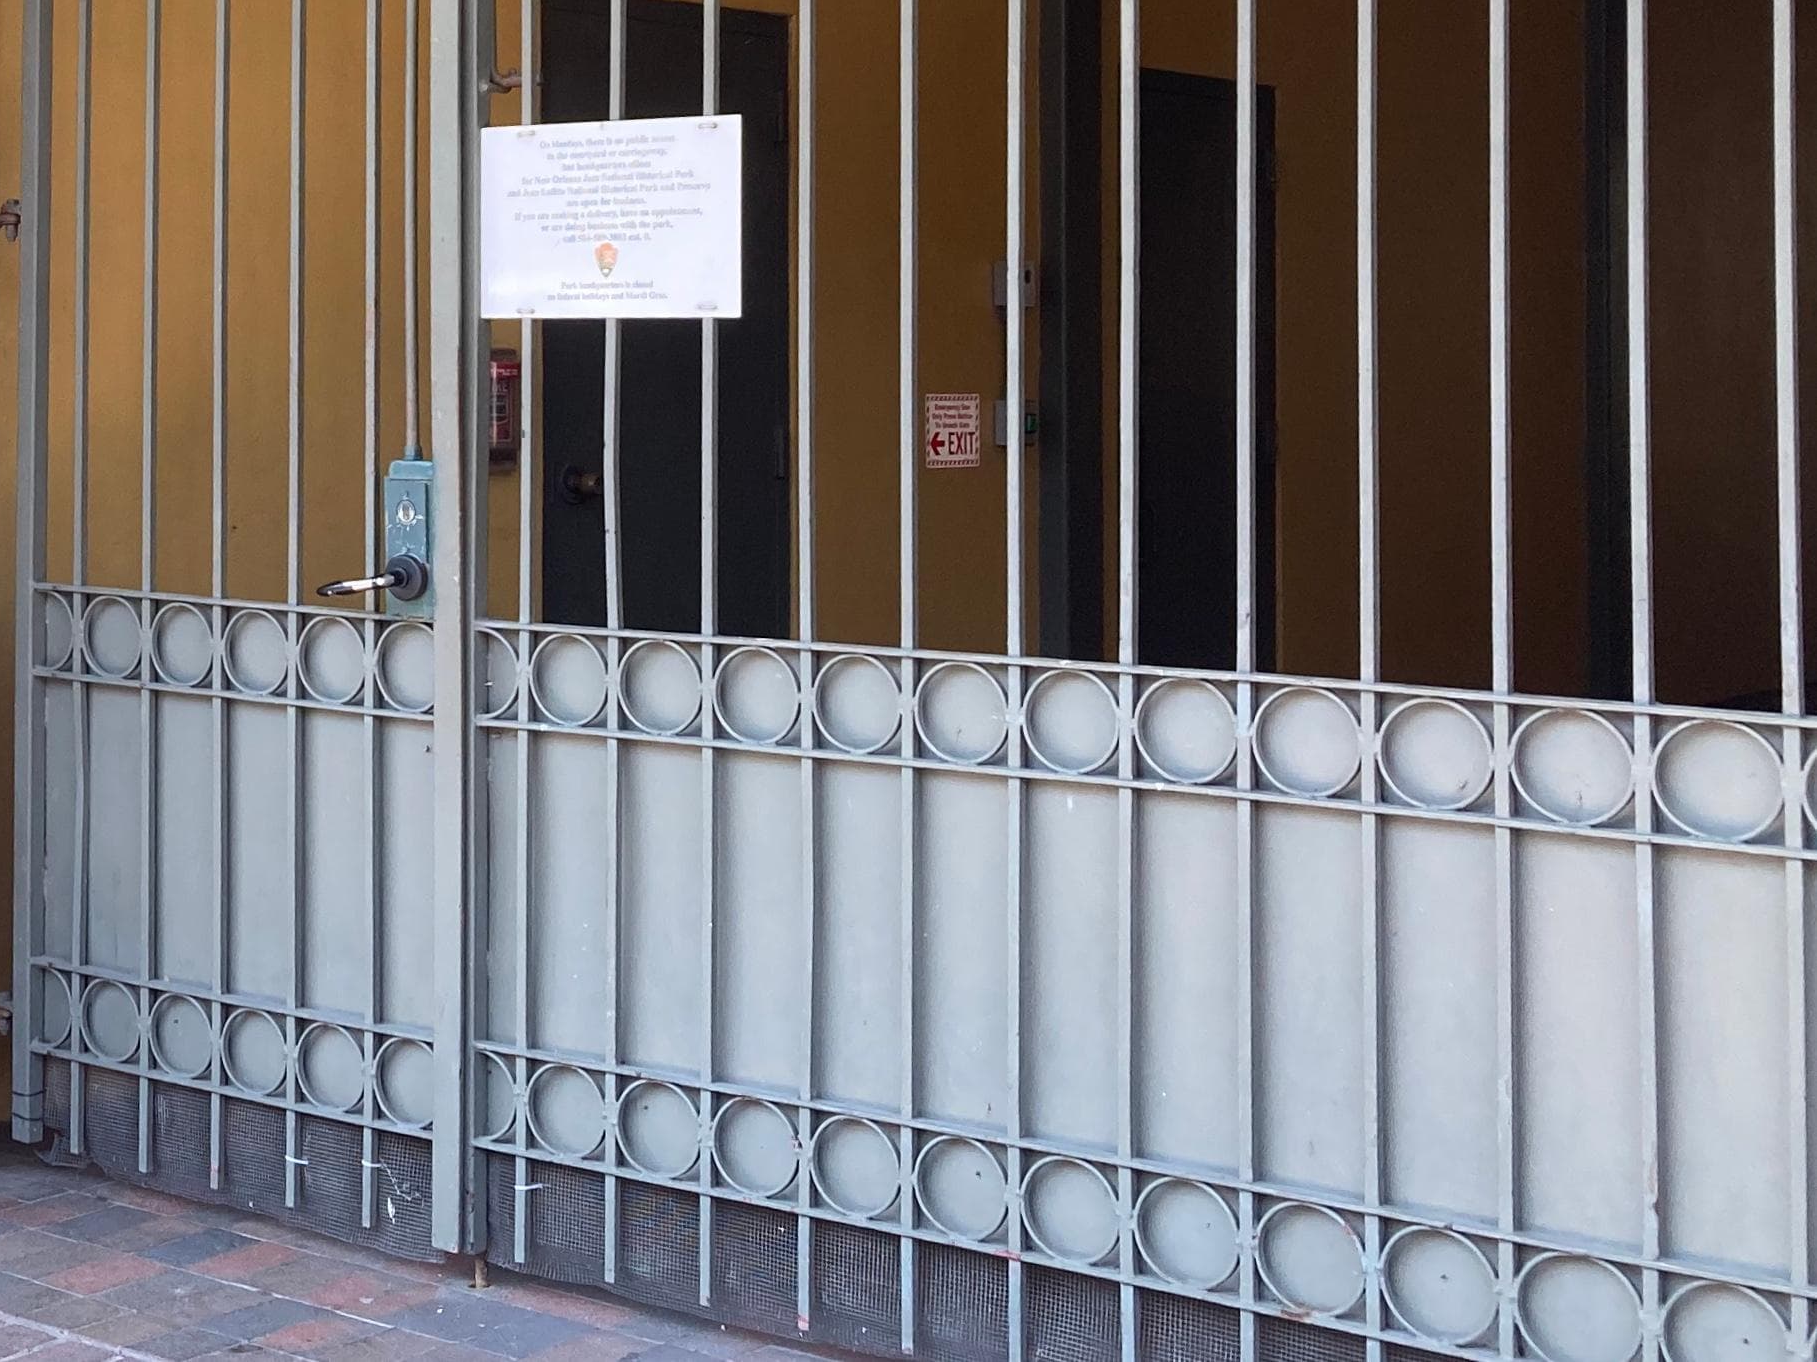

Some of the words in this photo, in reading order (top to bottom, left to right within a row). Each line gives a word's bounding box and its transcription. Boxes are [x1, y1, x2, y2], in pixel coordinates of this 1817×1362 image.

[636, 171, 672, 179] Historical
[675, 170, 694, 178] Park
[601, 184, 637, 193] Historical
[565, 223, 585, 231] doing
[621, 221, 637, 229] with
[948, 432, 975, 455] EXIT
